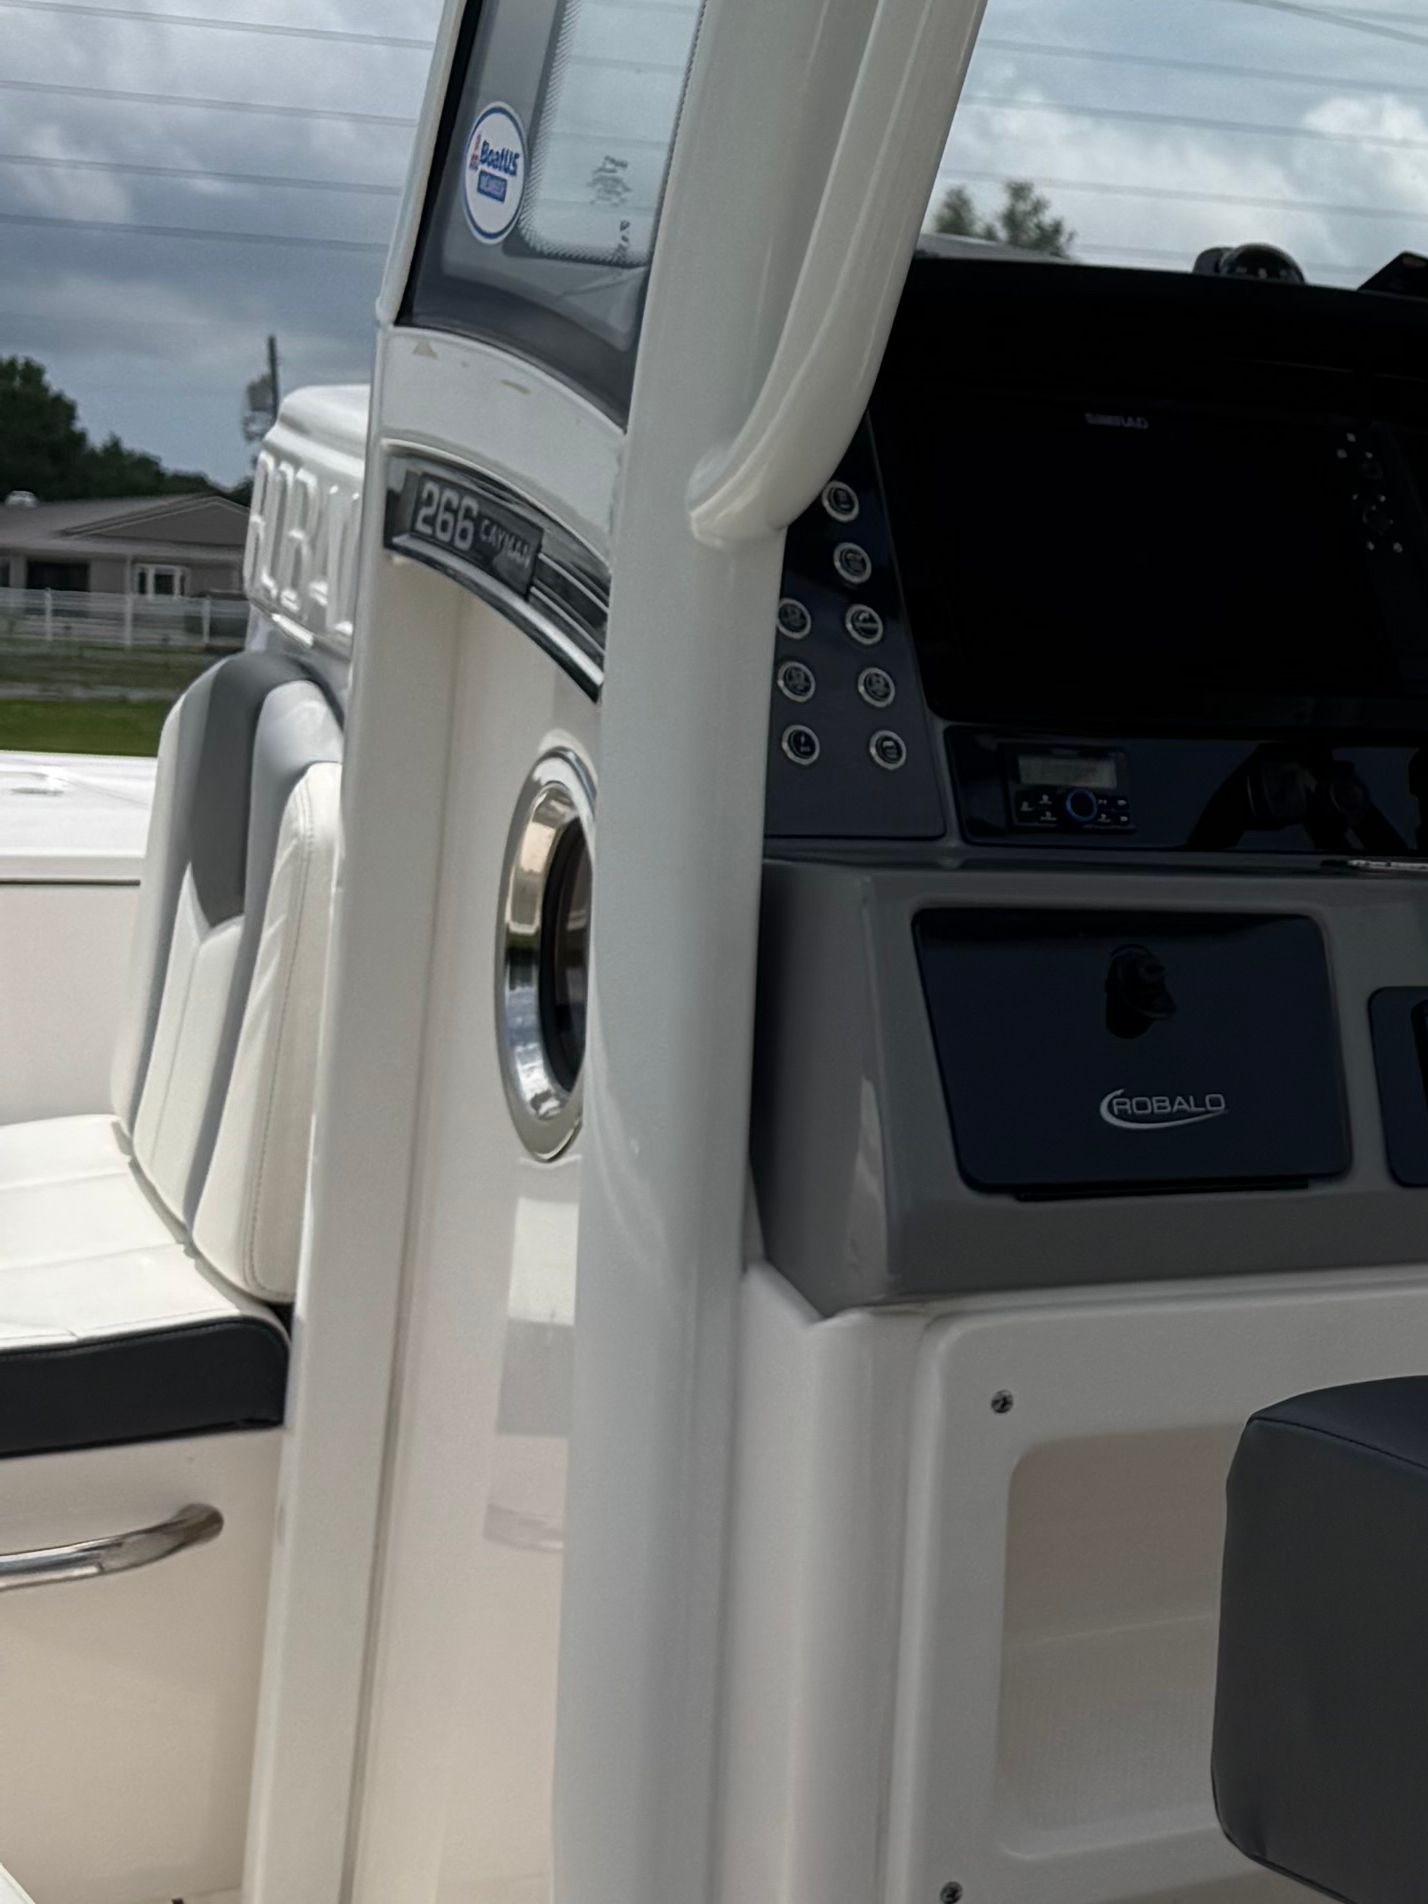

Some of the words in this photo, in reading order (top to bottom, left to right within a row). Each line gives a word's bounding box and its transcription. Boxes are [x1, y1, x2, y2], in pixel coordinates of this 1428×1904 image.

[414, 481, 480, 552] 266
[480, 519, 532, 569] CAYMAN
[1111, 1092, 1227, 1115] ROBALO
